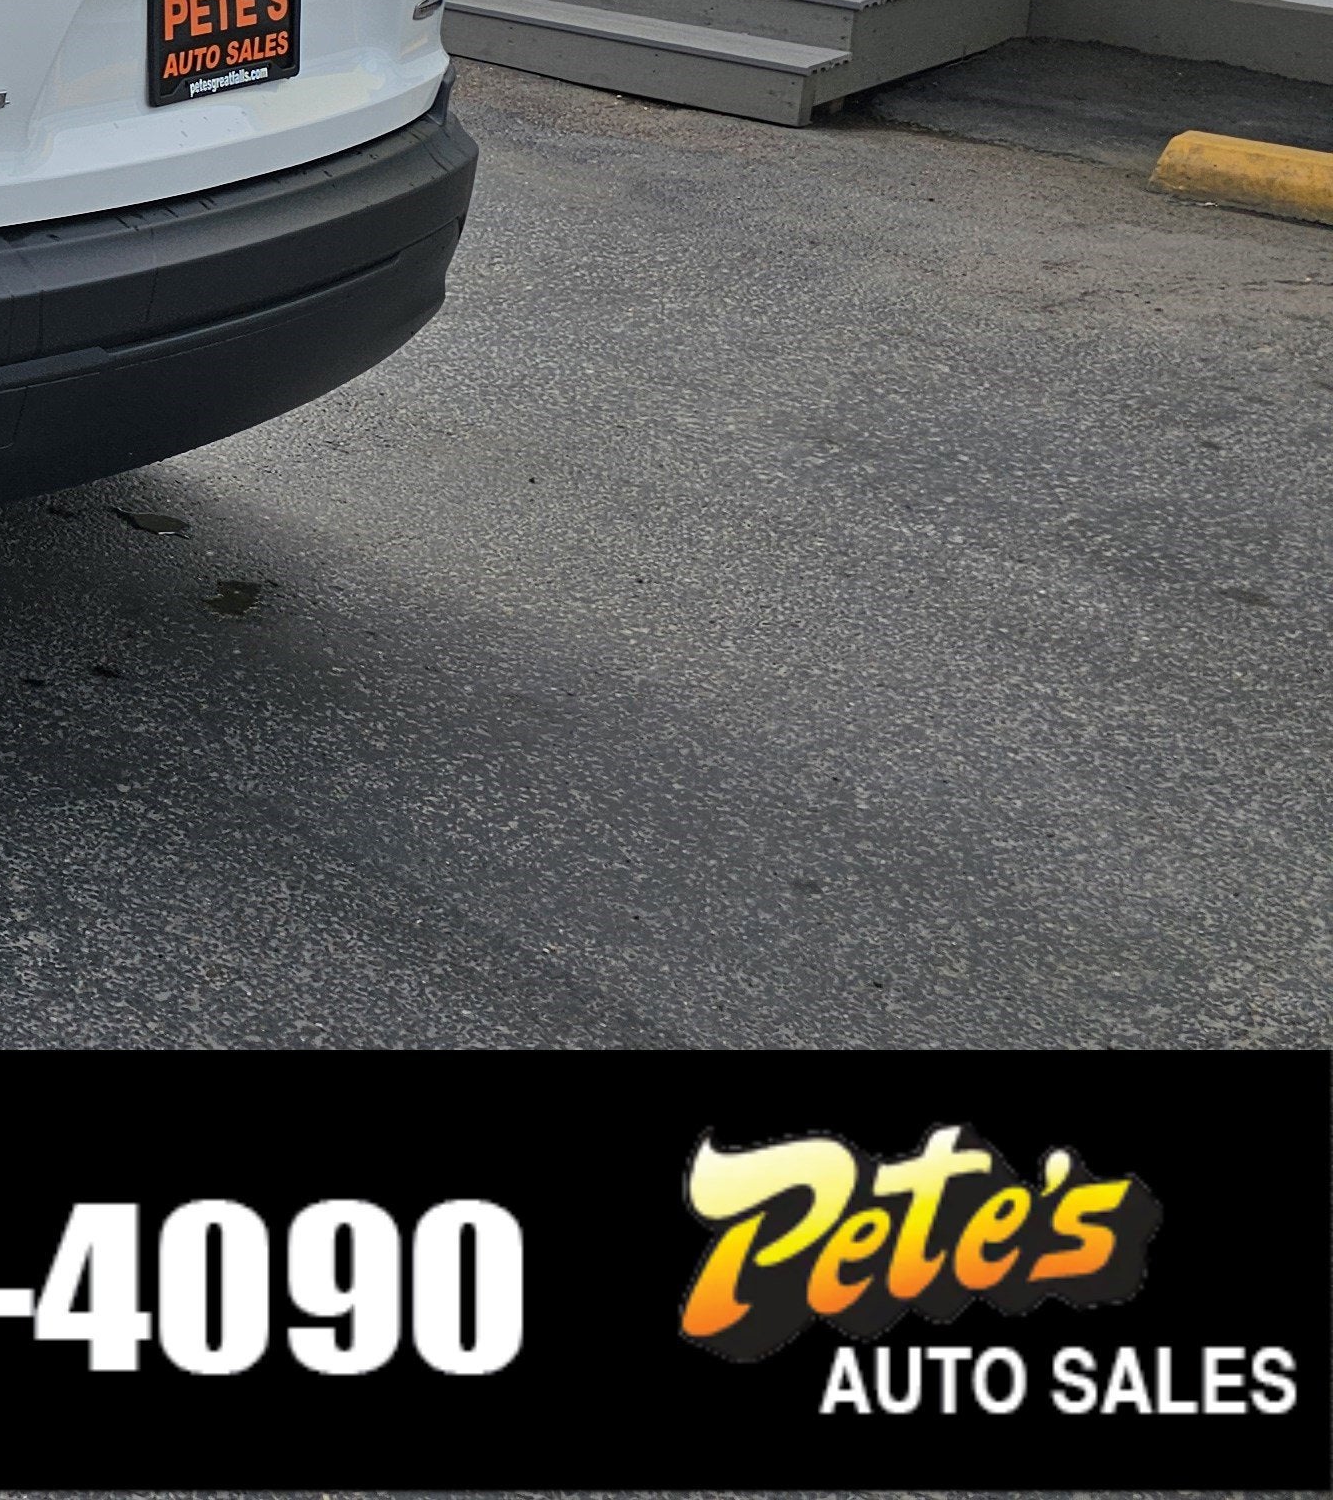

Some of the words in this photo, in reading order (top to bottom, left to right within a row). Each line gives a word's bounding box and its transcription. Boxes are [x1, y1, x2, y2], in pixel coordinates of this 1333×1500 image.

[163, 44, 221, 79] AUTO
[226, 30, 289, 66] SALES
[189, 67, 268, 98] petesgreatfalls.com
